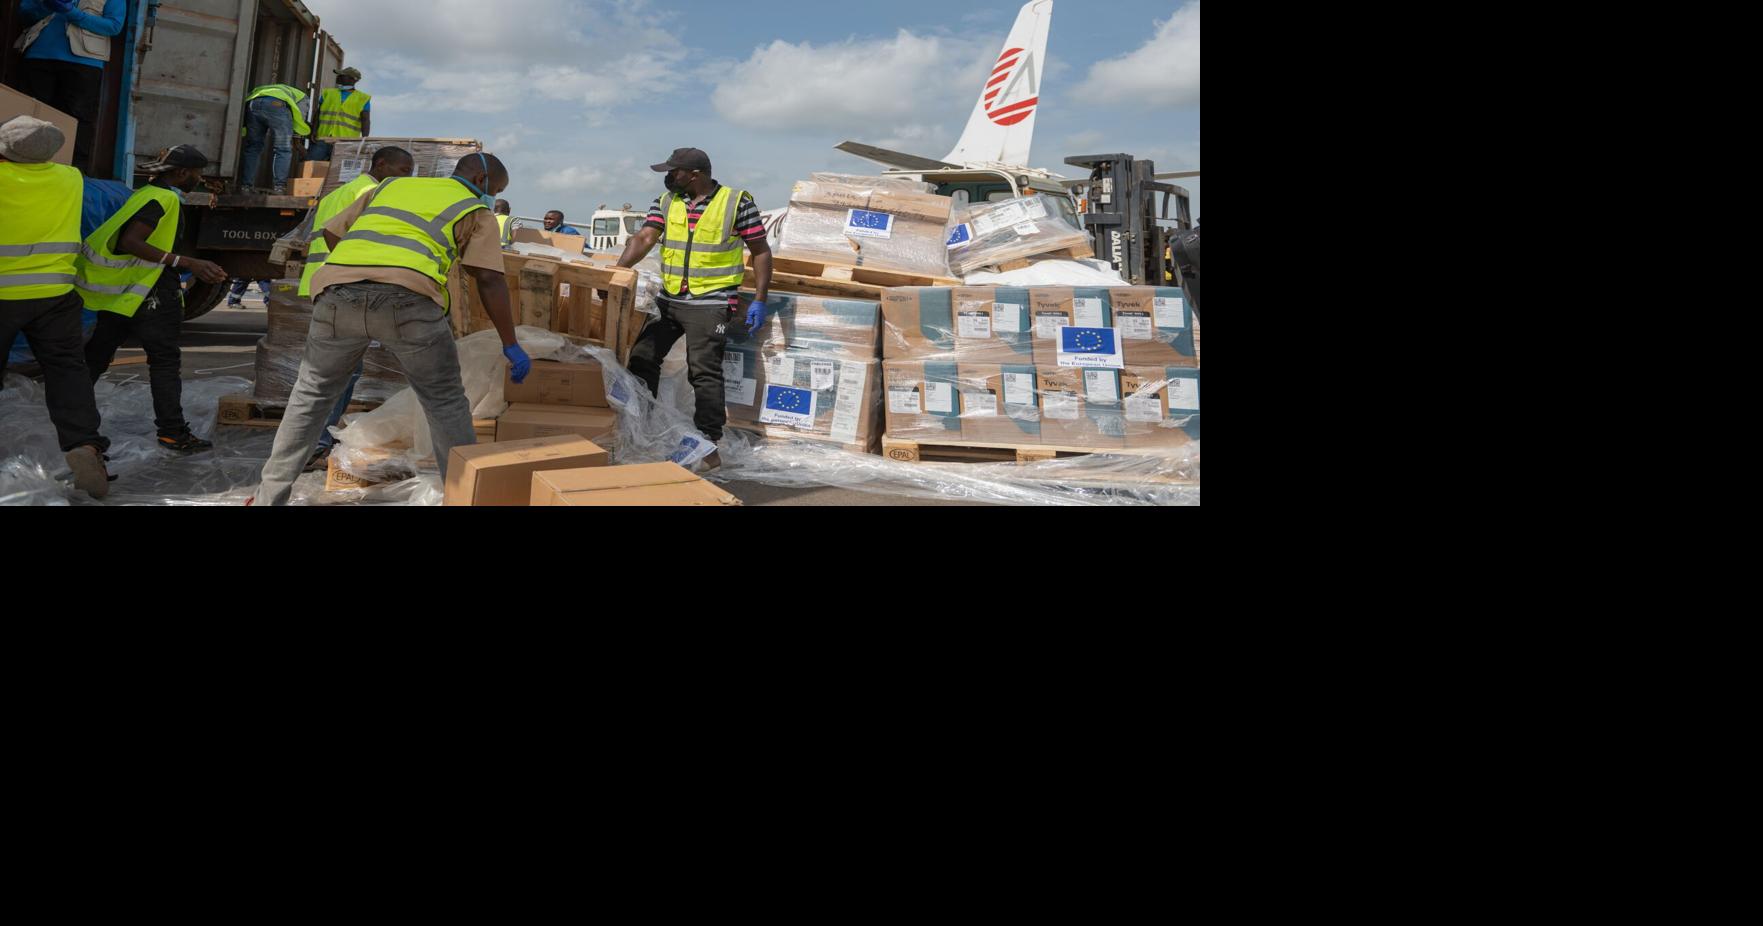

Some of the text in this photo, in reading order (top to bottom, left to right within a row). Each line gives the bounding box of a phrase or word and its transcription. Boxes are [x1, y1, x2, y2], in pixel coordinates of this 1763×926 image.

[222, 230, 277, 240] TOOL BOX
[1117, 301, 1141, 309] Tyvek
[893, 450, 911, 460] EPAL
